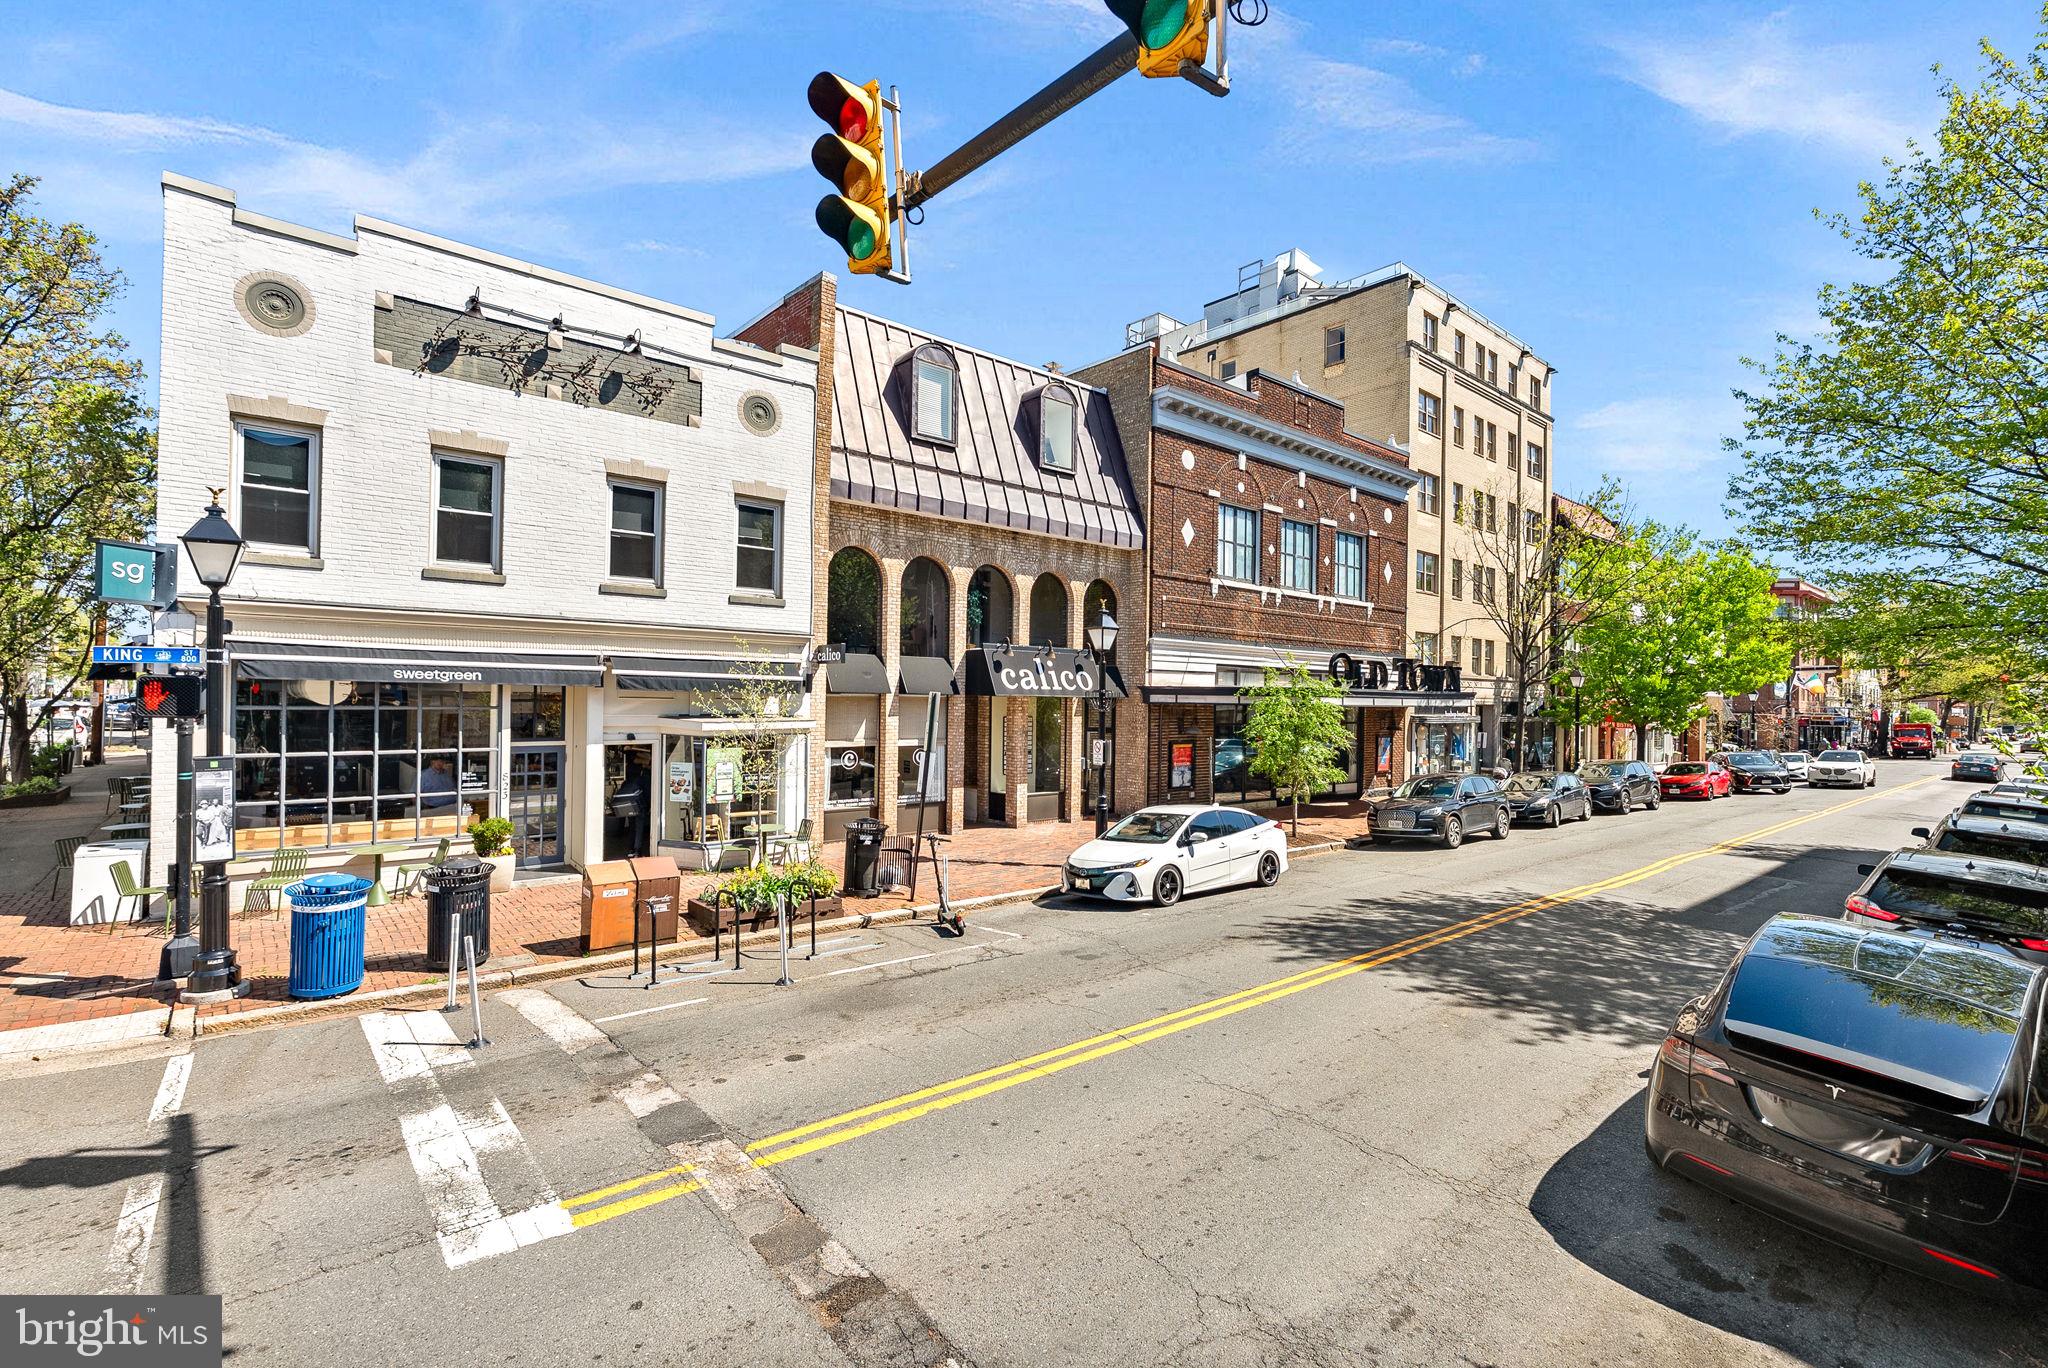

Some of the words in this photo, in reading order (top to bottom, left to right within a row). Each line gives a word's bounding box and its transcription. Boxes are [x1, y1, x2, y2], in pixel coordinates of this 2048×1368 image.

[112, 561, 144, 584] sg
[103, 648, 143, 661] KING
[817, 647, 841, 662] calico
[393, 669, 482, 683] sweetgreen
[1000, 657, 1093, 691] calico
